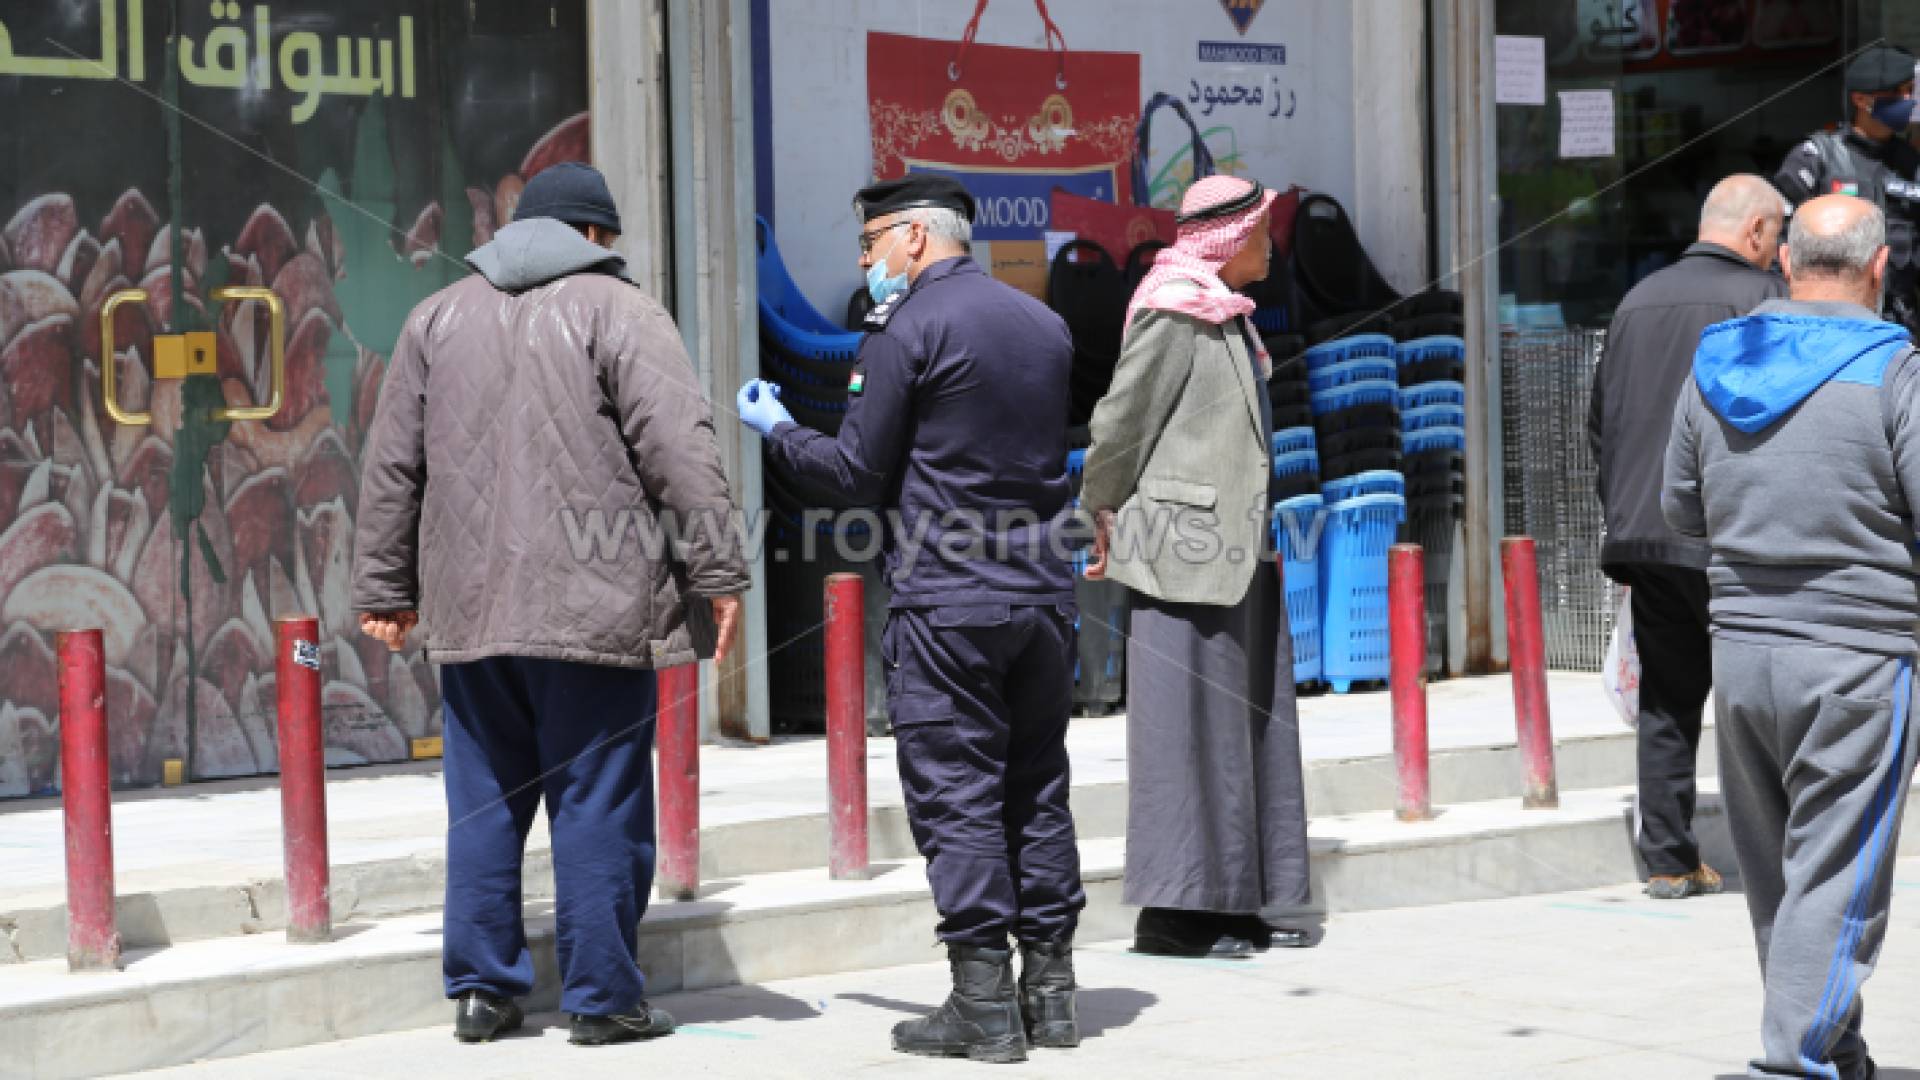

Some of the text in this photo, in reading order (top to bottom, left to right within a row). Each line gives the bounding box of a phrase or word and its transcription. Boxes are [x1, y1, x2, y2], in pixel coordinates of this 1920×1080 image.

[179, 0, 416, 124] اسواق
[1188, 76, 1296, 118] رز محمود
[973, 196, 1048, 227] MOOD
